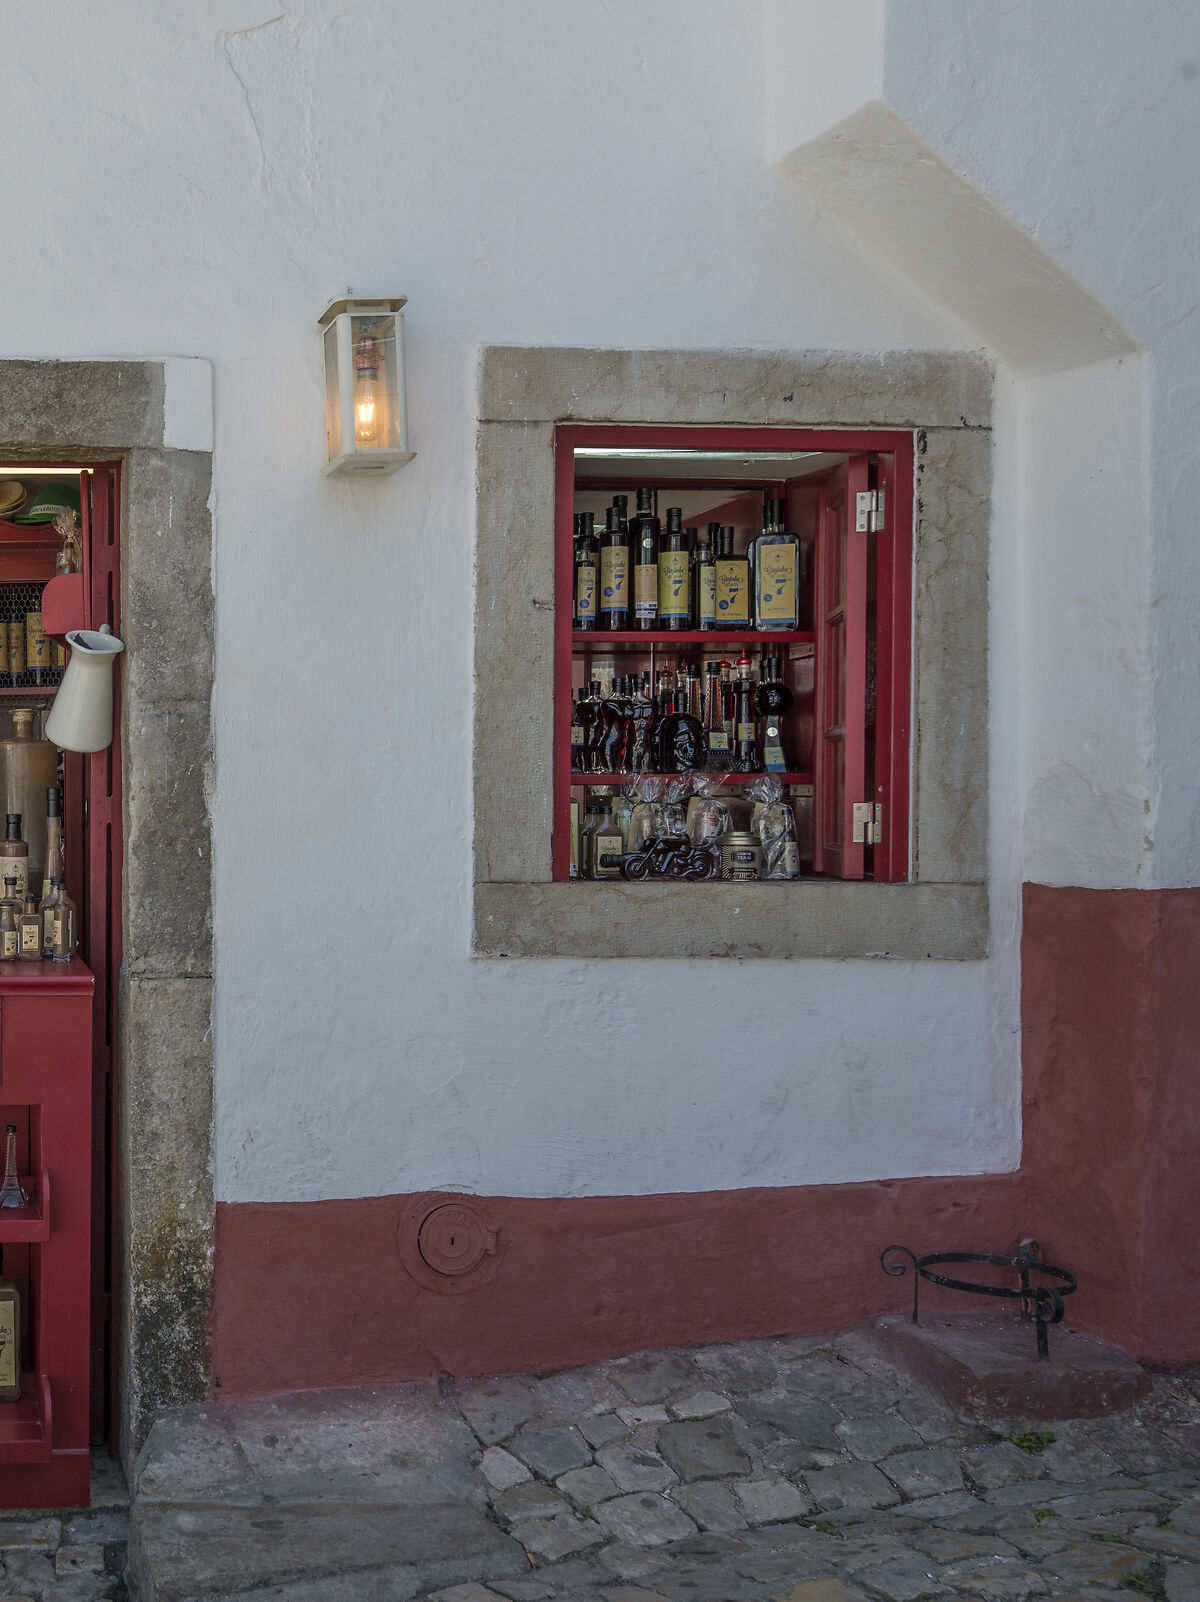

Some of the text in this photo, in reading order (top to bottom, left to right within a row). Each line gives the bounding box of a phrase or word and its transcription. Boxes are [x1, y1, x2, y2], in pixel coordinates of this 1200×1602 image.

[615, 574, 624, 590] 7
[673, 580, 682, 596] 7
[776, 579, 786, 595] 7
[729, 588, 738, 604] 7
